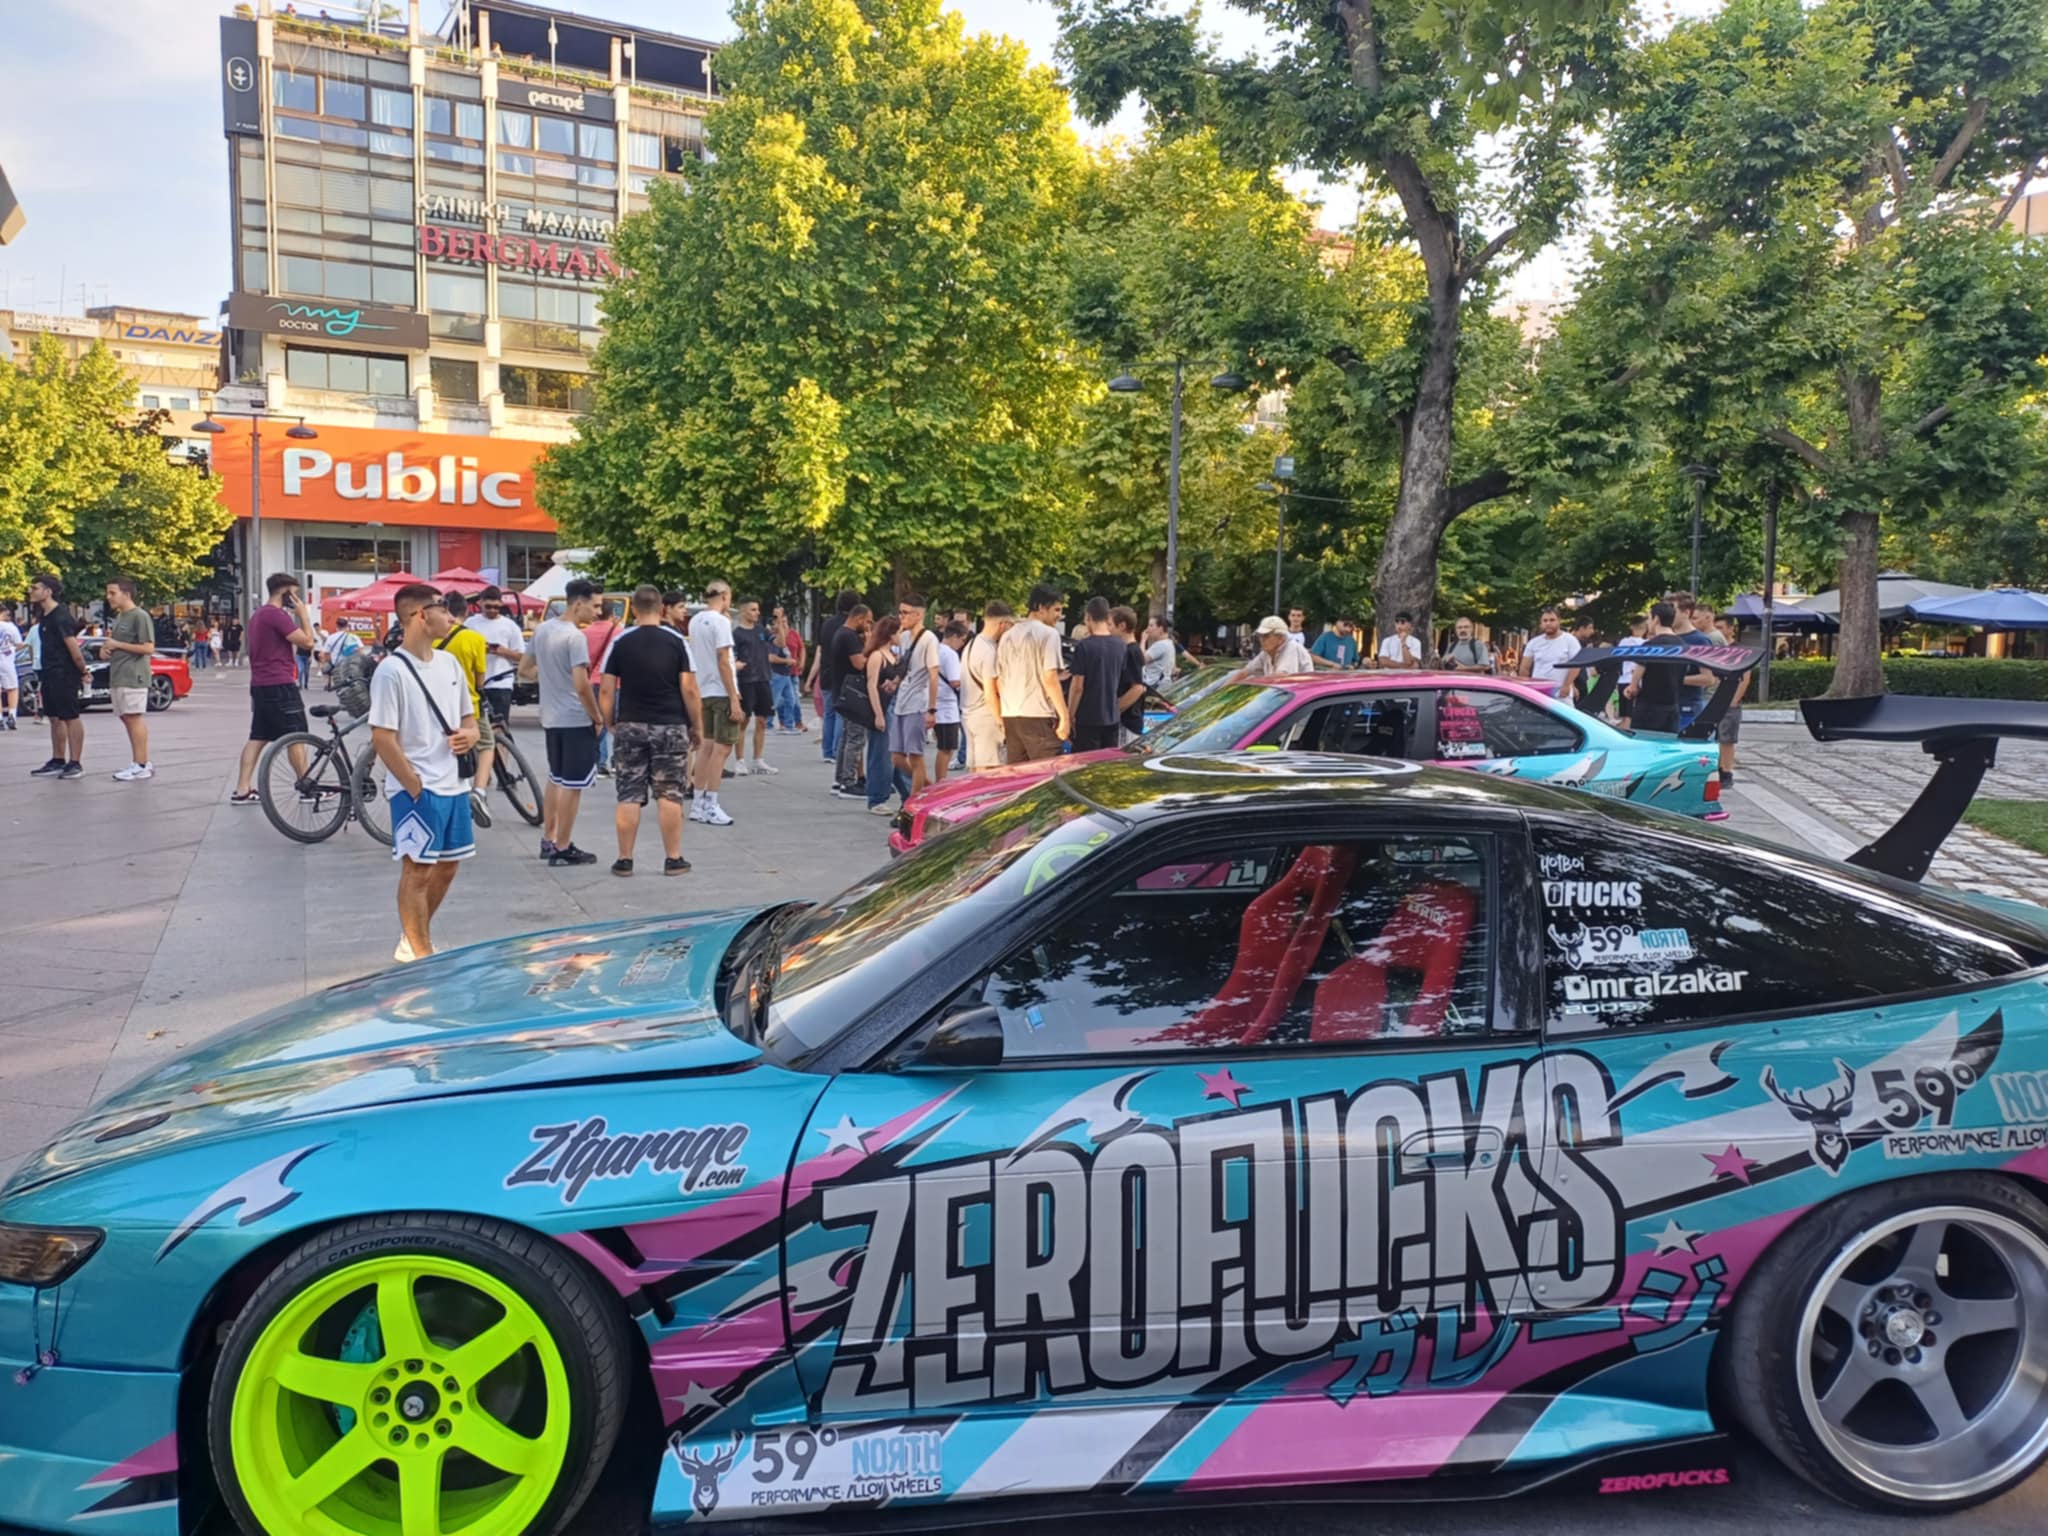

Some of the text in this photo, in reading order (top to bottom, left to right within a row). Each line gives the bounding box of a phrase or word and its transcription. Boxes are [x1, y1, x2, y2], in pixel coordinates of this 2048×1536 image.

[125, 325, 222, 345] DANZ
[279, 319, 319, 331] DOCTOR
[282, 447, 521, 508] Public
[1588, 926, 1634, 953] 59°
[1591, 968, 1749, 999] mralzakar
[1871, 1062, 1976, 1129] 59°
[1889, 1130, 2000, 1155] PERFORMANCE
[816, 1050, 1628, 1414] ZEROFUCKS
[328, 1235, 437, 1262] CATCHPOWER
[1325, 1254, 1728, 1408] ガレージ
[751, 1428, 838, 1483] 59°
[751, 1478, 941, 1505] PERFORMANCE ALLOY WHEELS
